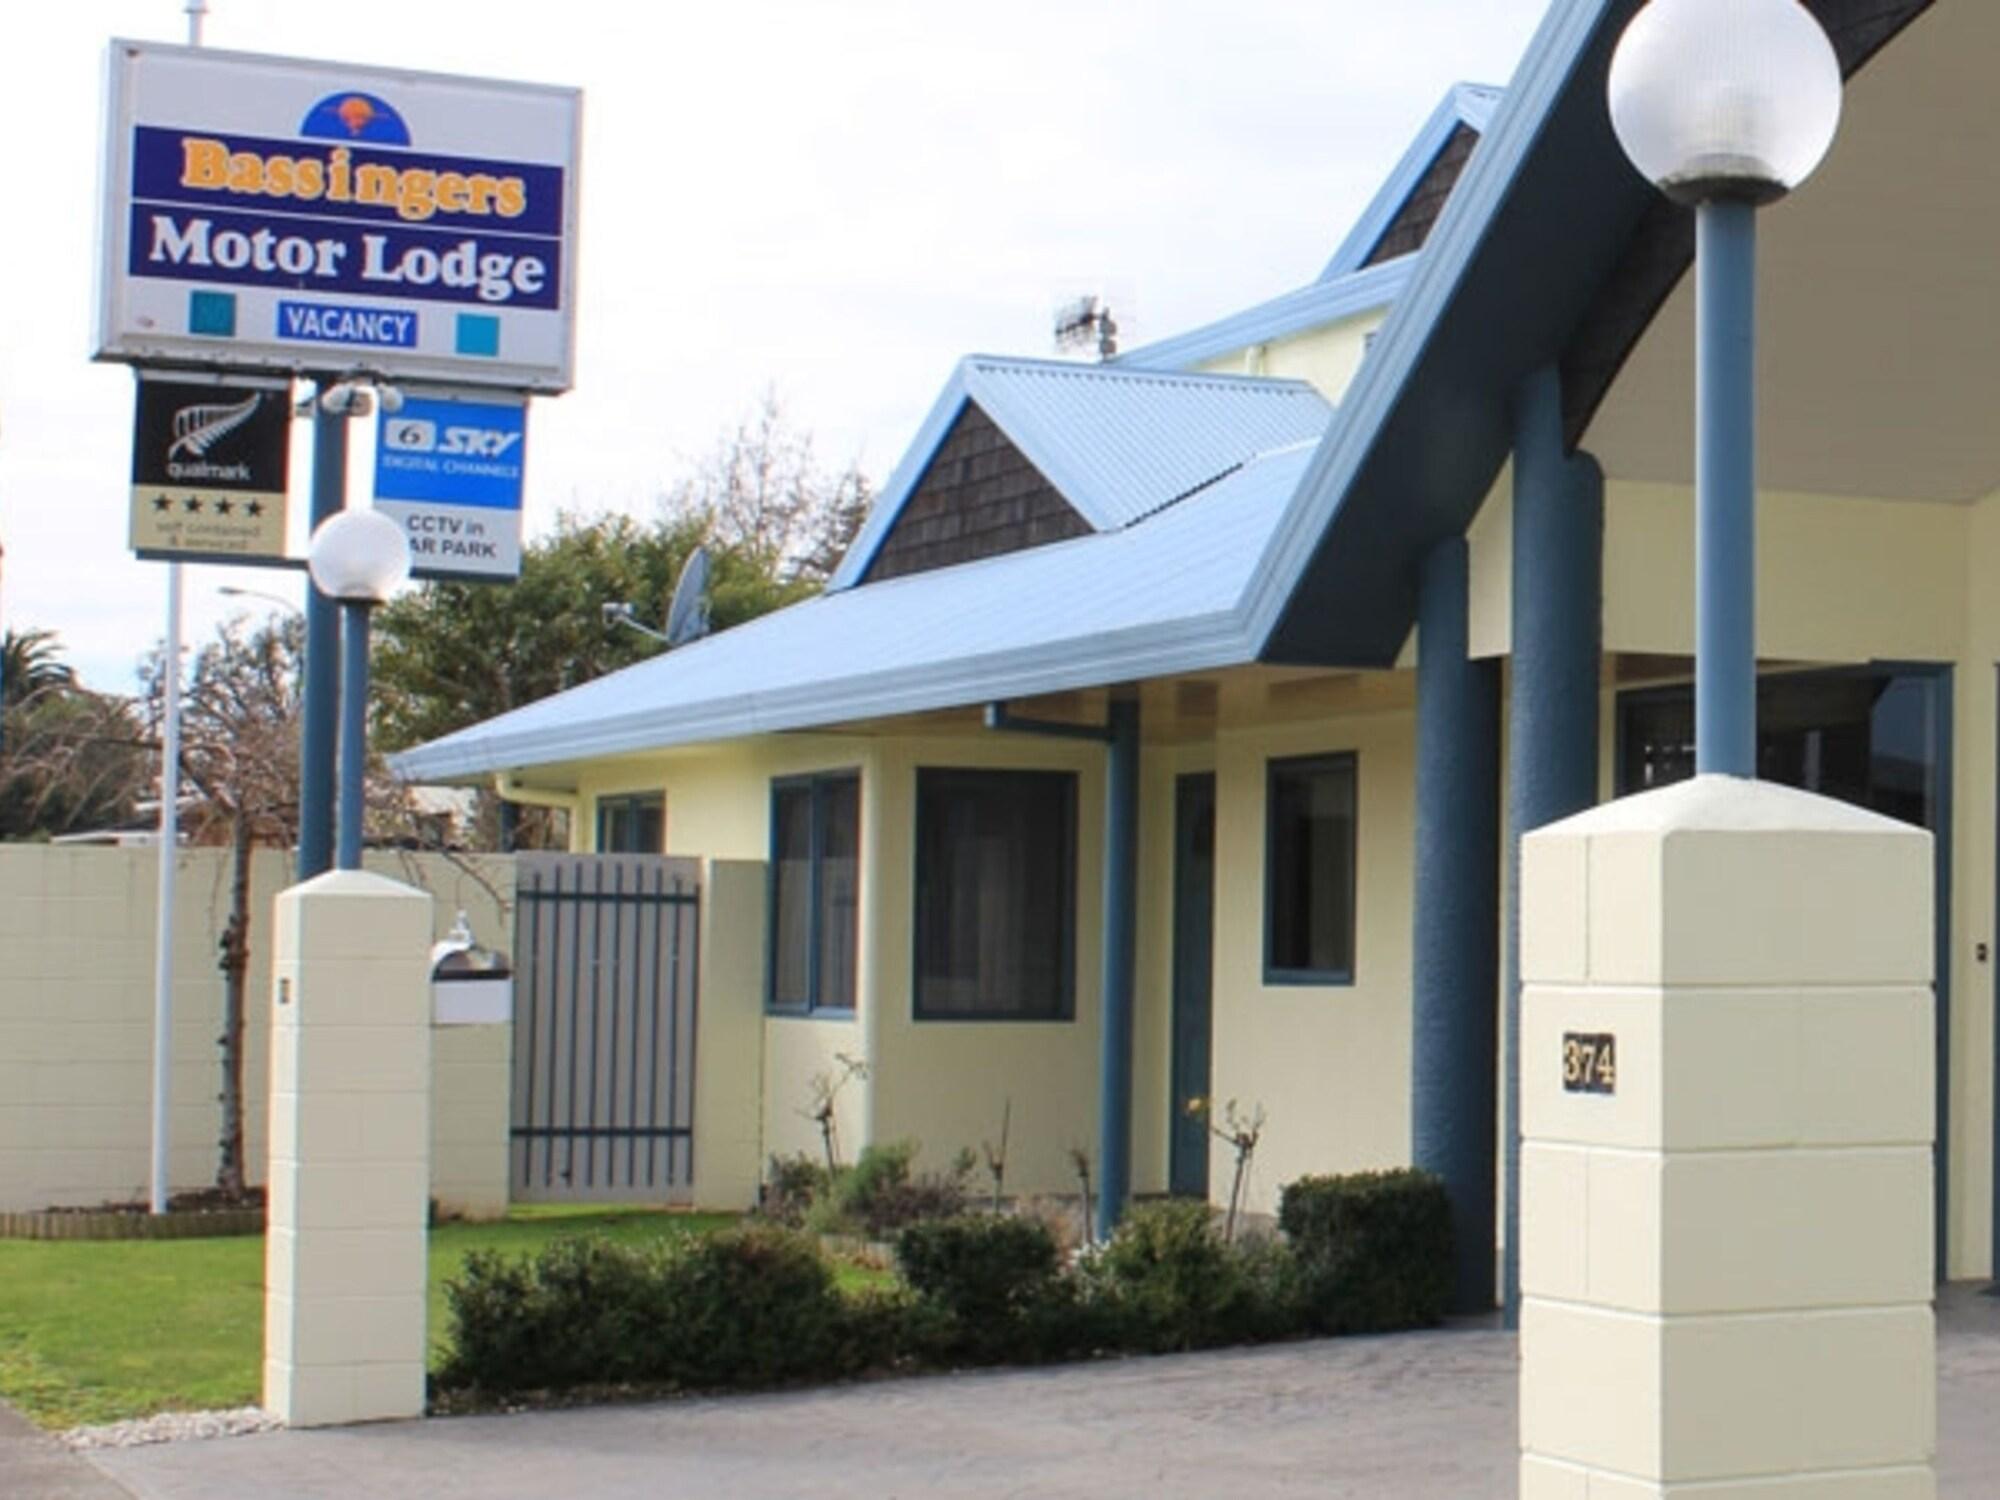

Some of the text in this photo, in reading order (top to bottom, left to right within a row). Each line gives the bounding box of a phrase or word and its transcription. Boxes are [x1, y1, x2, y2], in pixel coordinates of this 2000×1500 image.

[180, 137, 526, 220] Bassingers
[149, 215, 545, 301] Motor Lodge
[286, 306, 412, 343] VACANCY
[438, 427, 522, 456] SKY
[167, 460, 251, 481] qualmark
[407, 513, 485, 537] CCTV in
[409, 536, 497, 559] AR PARK
[1563, 1039, 1615, 1085] 374
